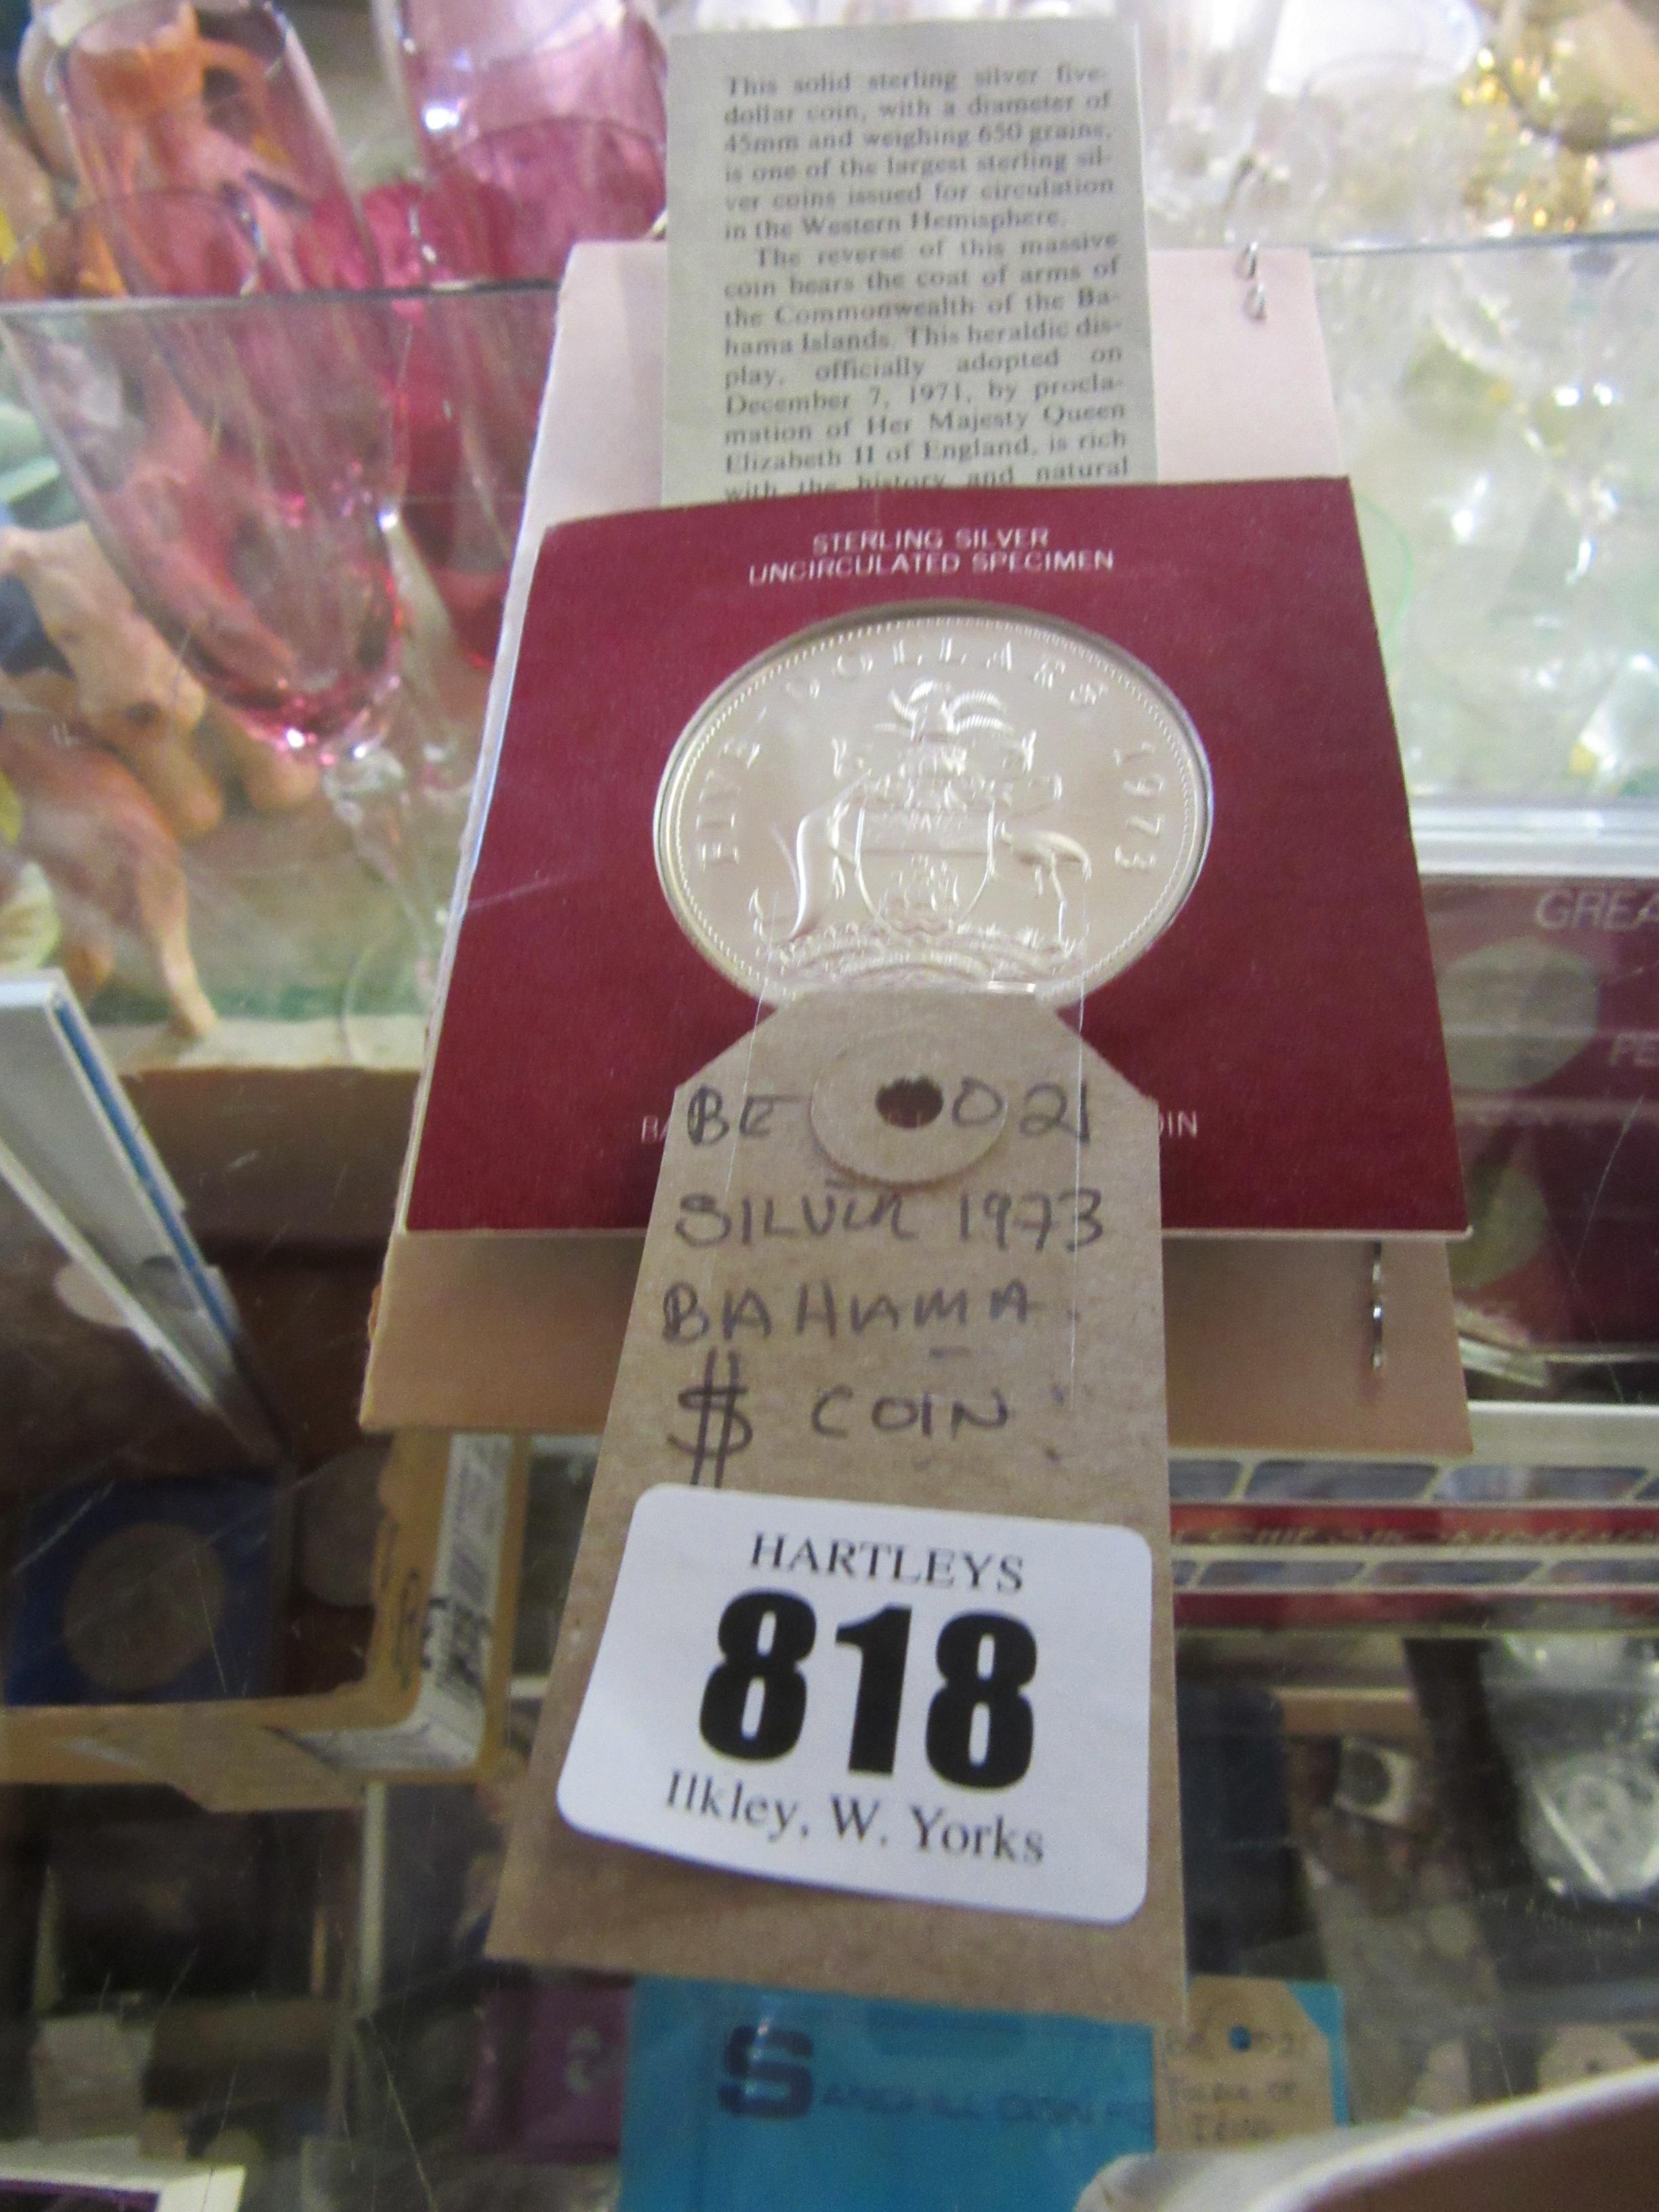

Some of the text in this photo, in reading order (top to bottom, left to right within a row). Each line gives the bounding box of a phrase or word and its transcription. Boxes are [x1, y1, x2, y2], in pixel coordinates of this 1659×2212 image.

[729, 76, 778, 96] This
[794, 73, 851, 94] solid
[867, 71, 957, 91] sterling
[975, 68, 1038, 87] silver
[724, 105, 794, 125] dollar
[880, 98, 930, 118] with
[943, 101, 955, 117] a
[968, 95, 1073, 117] diameter
[1086, 91, 1111, 110] of
[724, 136, 798, 153] 45mm
[809, 132, 852, 150] and
[863, 127, 969, 148] weighing
[725, 166, 741, 183] is
[753, 165, 796, 182] one
[806, 159, 830, 178] of
[841, 159, 877, 177] the
[888, 155, 966, 178] largest
[977, 150, 1066, 173] sterling
[725, 177, 1113, 211] ver coins issued for circulation
[725, 222, 745, 240] in
[756, 219, 791, 239] the
[801, 210, 900, 235] Western
[758, 232, 1118, 268] The reverse of this massive
[724, 259, 1119, 299] coin bears the coat of arms of
[724, 309, 762, 329] the
[775, 295, 973, 326] Commonwealth
[987, 295, 1012, 313] of
[1026, 291, 1063, 310] the
[725, 337, 792, 357] hama
[908, 325, 958, 347] This
[968, 322, 1068, 344] heraldic
[815, 354, 925, 384] officially
[957, 348, 1059, 375] adopted
[1092, 346, 1122, 364] on
[725, 389, 850, 417] December
[989, 380, 1016, 403] by
[725, 405, 1124, 445] mation of Her Majesty Queen
[726, 449, 841, 474] Elizabeth
[887, 443, 911, 462] of
[1050, 434, 1068, 452] is
[1079, 429, 1127, 450] rich
[1036, 456, 1129, 480] natural
[813, 527, 1049, 556] STERLING SILVER
[749, 548, 1114, 586] UNCIRCULATED SPECIMEN
[959, 1187, 1104, 1252] 1973
[661, 1277, 1042, 1345] BAHAMA
[812, 1385, 1013, 1440] COIN
[751, 1531, 1024, 1594] HARTLEYS
[698, 1586, 1038, 1795] 818
[666, 1769, 1044, 1864] Ilkley, W. Yorks
